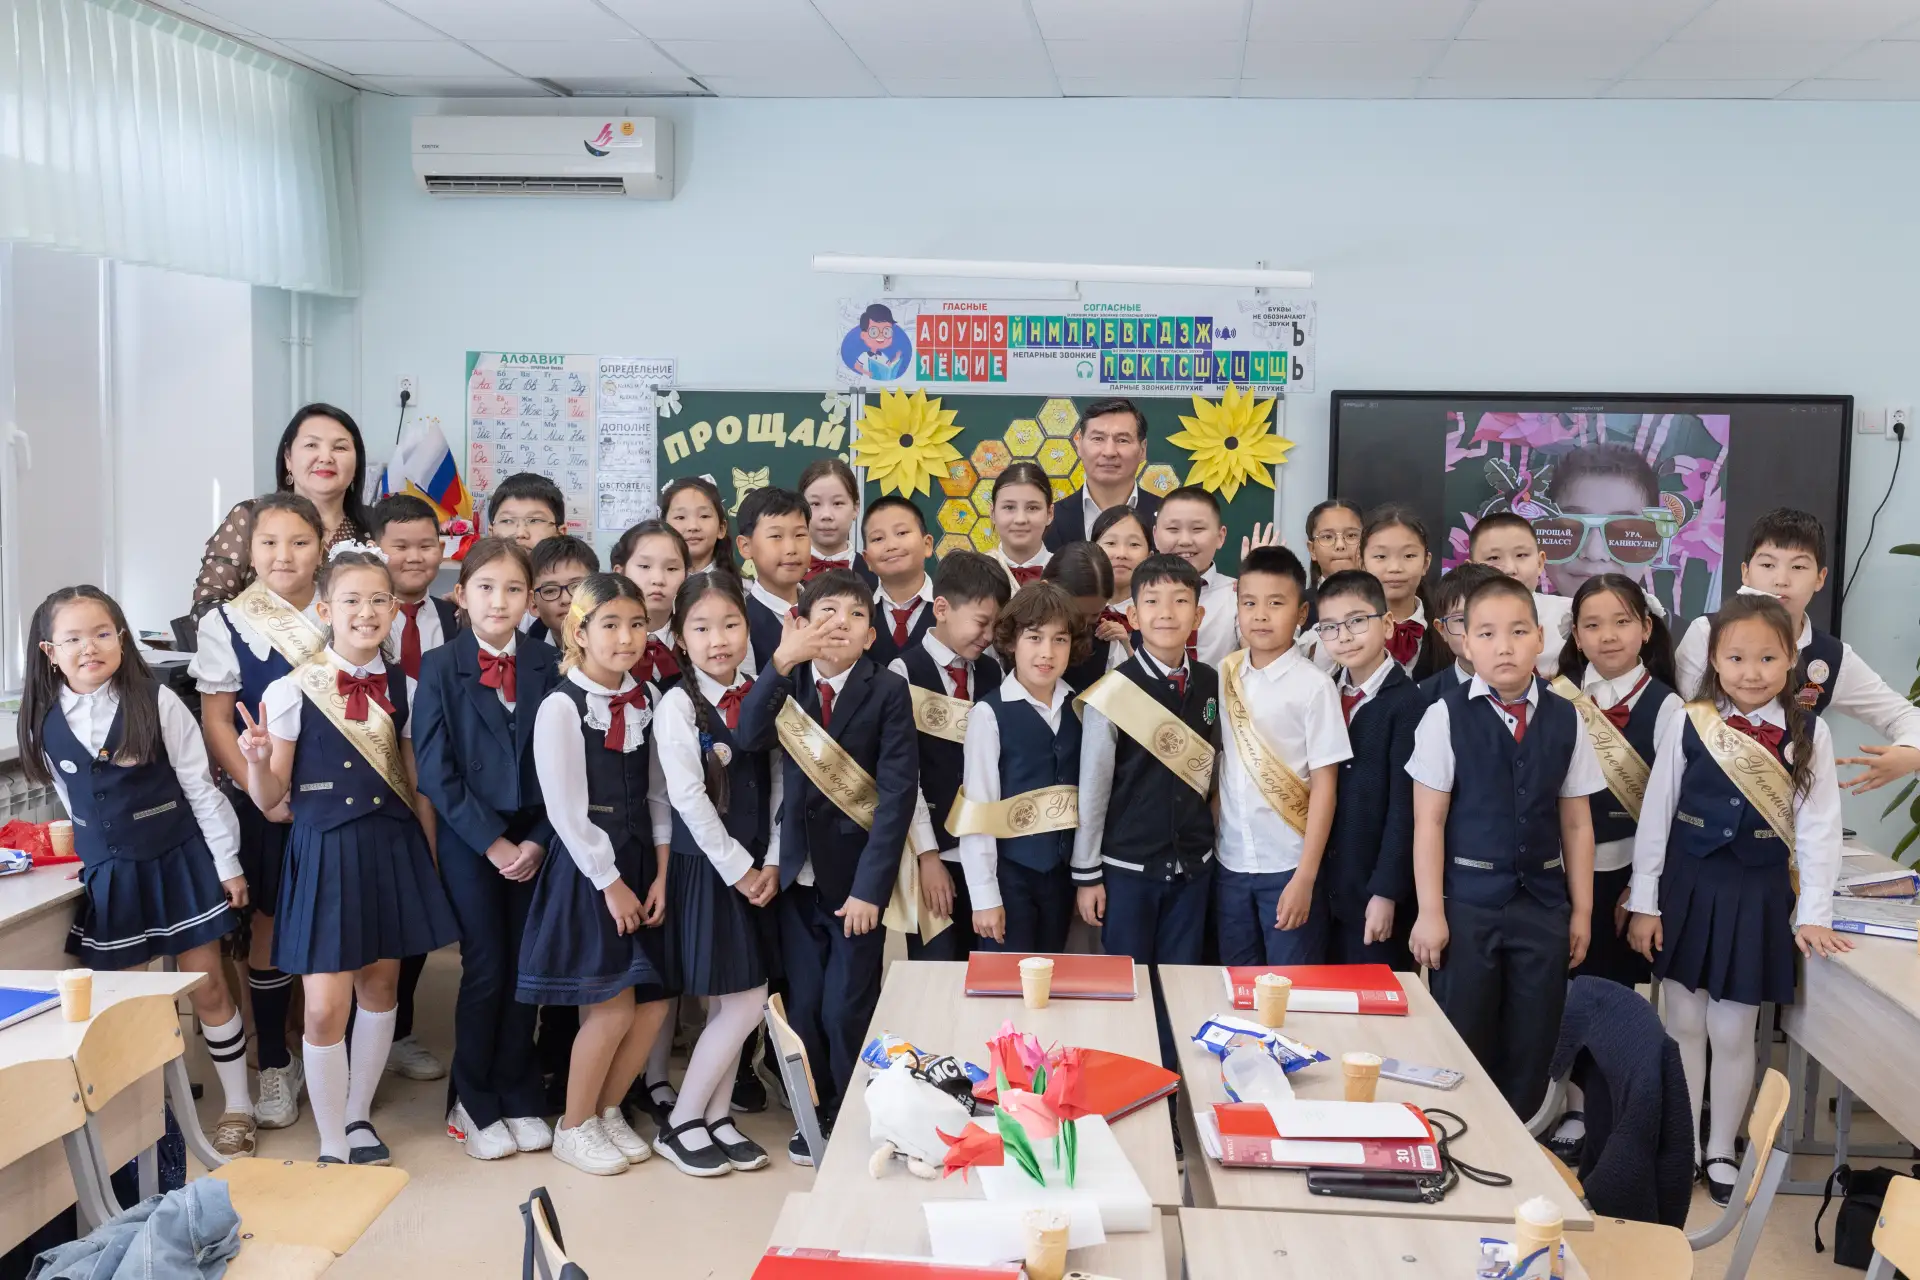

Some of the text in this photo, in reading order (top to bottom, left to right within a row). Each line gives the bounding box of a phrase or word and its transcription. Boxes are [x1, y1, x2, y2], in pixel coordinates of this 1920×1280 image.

[942, 302, 988, 311] ГЛАСНЫЕ
[1083, 303, 1142, 312] СОГЛАСНЫЕ
[920, 322, 930, 342] А
[958, 322, 968, 342] У
[973, 322, 987, 342] Ы
[994, 322, 1004, 342] Э
[1012, 316, 1211, 344] Й Н М Л Р Б В Г Д З Ж
[1292, 321, 1305, 347] Ъ
[500, 354, 566, 365] АЛФАВИТ
[1013, 351, 1057, 359] НЕПАРНЫЕ
[600, 364, 673, 375] ОПРЕДЕЛЕНИЕ
[1104, 356, 1287, 379] П Ф К Т С Ш Х Ц Ч Щ
[1292, 356, 1304, 380] Ь
[1141, 384, 1204, 392] ЗВОНКИЕ/ГЛУХИЕ
[600, 423, 651, 433] ДОПОЛНЕ
[599, 482, 651, 490] ОБСТОЯТЕЛЬ
[1536, 528, 1574, 538] ПРОЩАЙ,
[1624, 531, 1643, 539] УРА,
[1542, 538, 1572, 546] КЛАСС!
[1608, 539, 1658, 548] КАНИКУЛЫ!
[783, 720, 833, 774] Ученик
[829, 773, 855, 798] года
[1260, 771, 1291, 803] года
[1289, 800, 1308, 821] 20
[1397, 1149, 1410, 1164] 30
